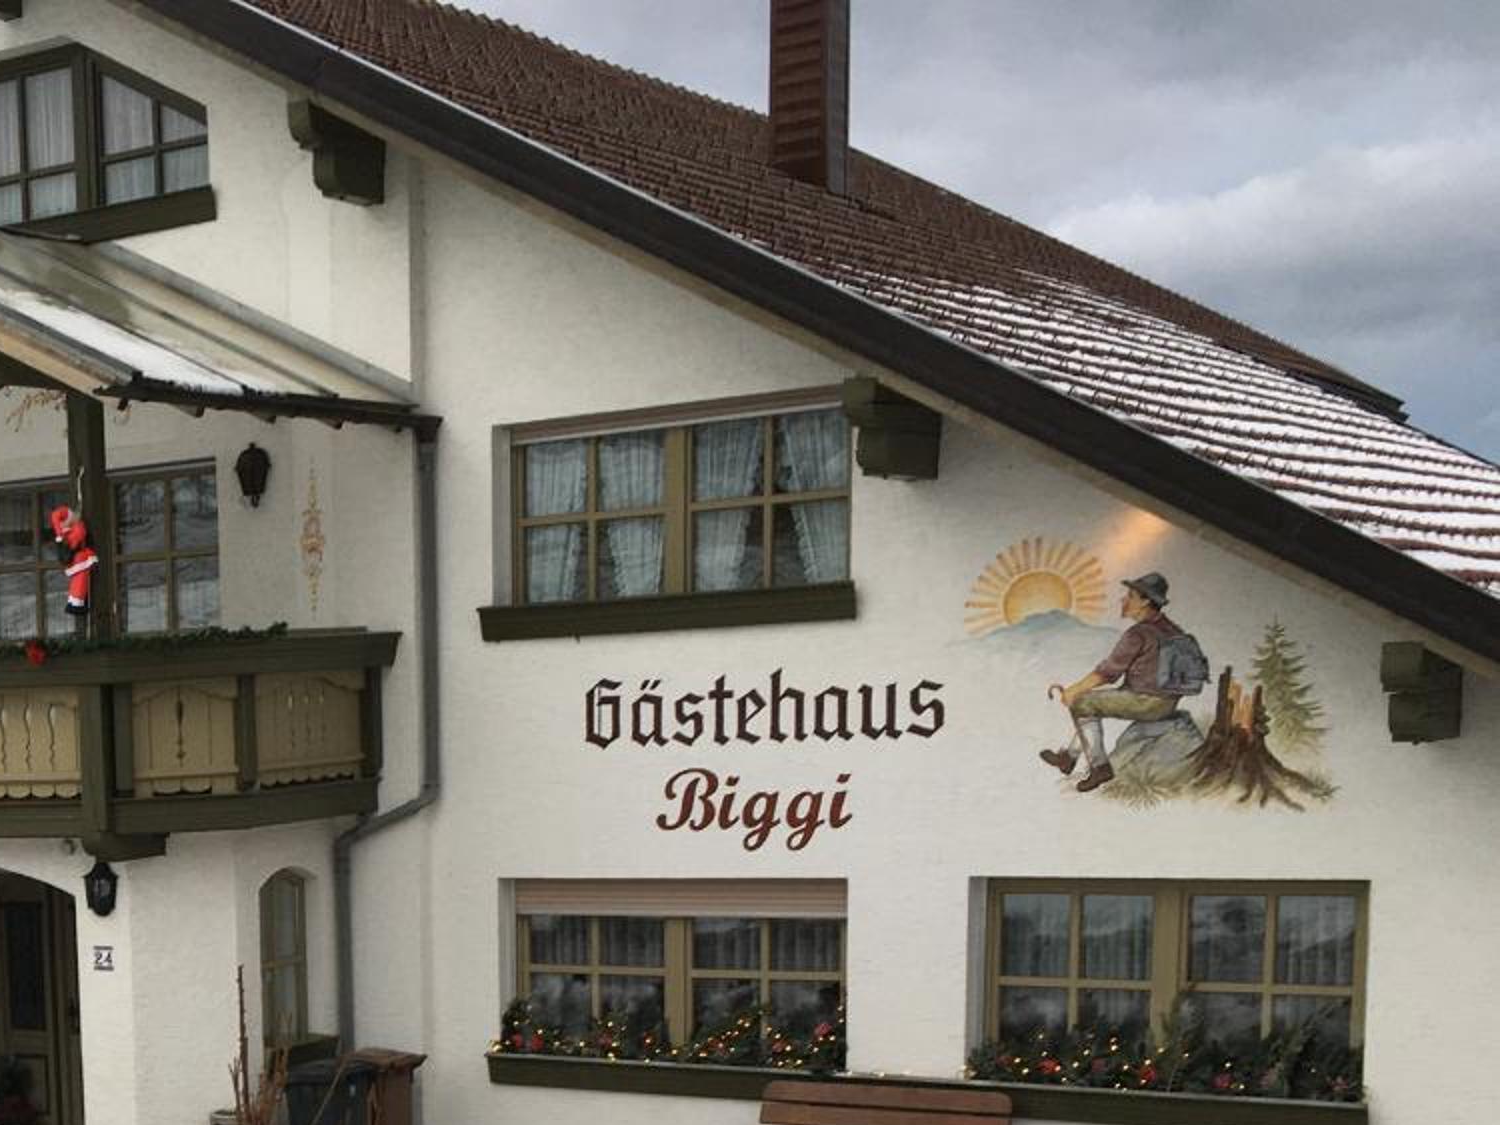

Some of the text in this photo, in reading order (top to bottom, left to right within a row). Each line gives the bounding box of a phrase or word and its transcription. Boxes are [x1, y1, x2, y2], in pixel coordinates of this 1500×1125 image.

[585, 667, 946, 750] Gästehaus
[656, 767, 853, 851] Biggi
[94, 951, 113, 966] 24
